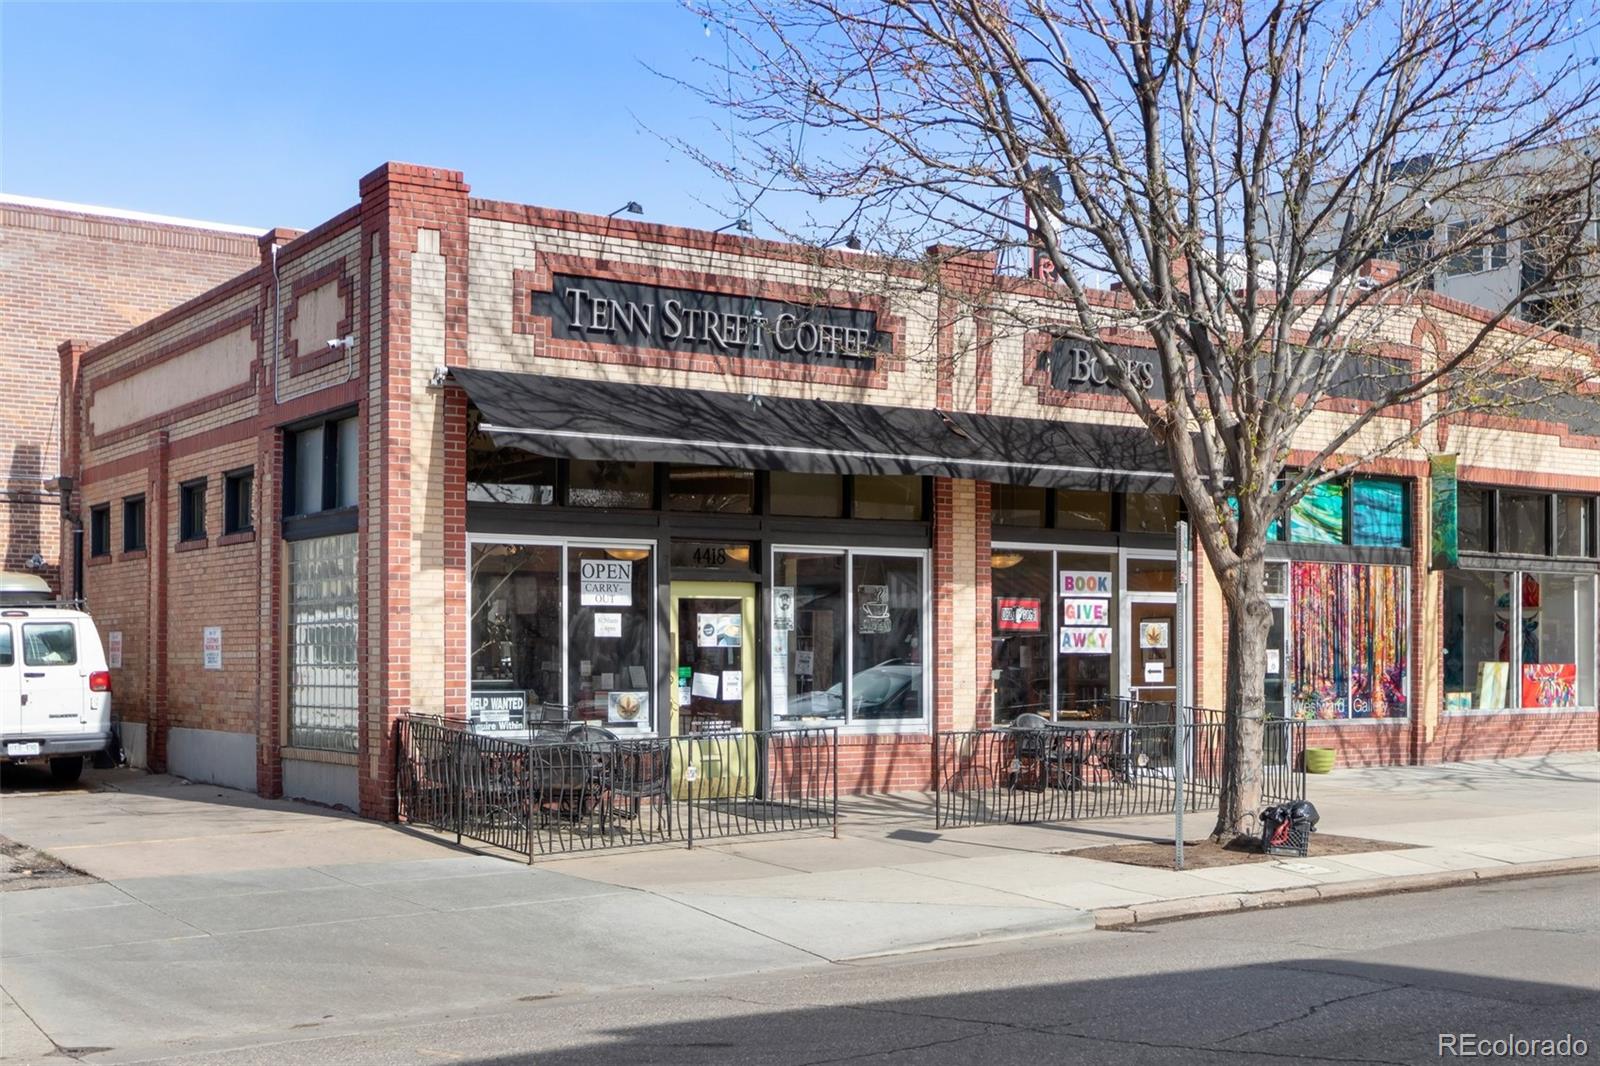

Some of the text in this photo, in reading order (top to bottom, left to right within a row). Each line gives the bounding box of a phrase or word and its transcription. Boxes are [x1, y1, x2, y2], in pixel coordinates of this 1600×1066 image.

[565, 287, 870, 358] TENN STREET COFFEE
[1069, 348, 1154, 390] BOKS
[692, 547, 726, 564] 4418
[582, 563, 631, 580] OPEN
[585, 583, 623, 593] CARRY-
[1064, 576, 1108, 592] BOOK
[595, 594, 614, 603] OUT
[1062, 632, 1108, 649] AWAY
[470, 697, 523, 710] HELP WANTED
[498, 721, 523, 730] Within
